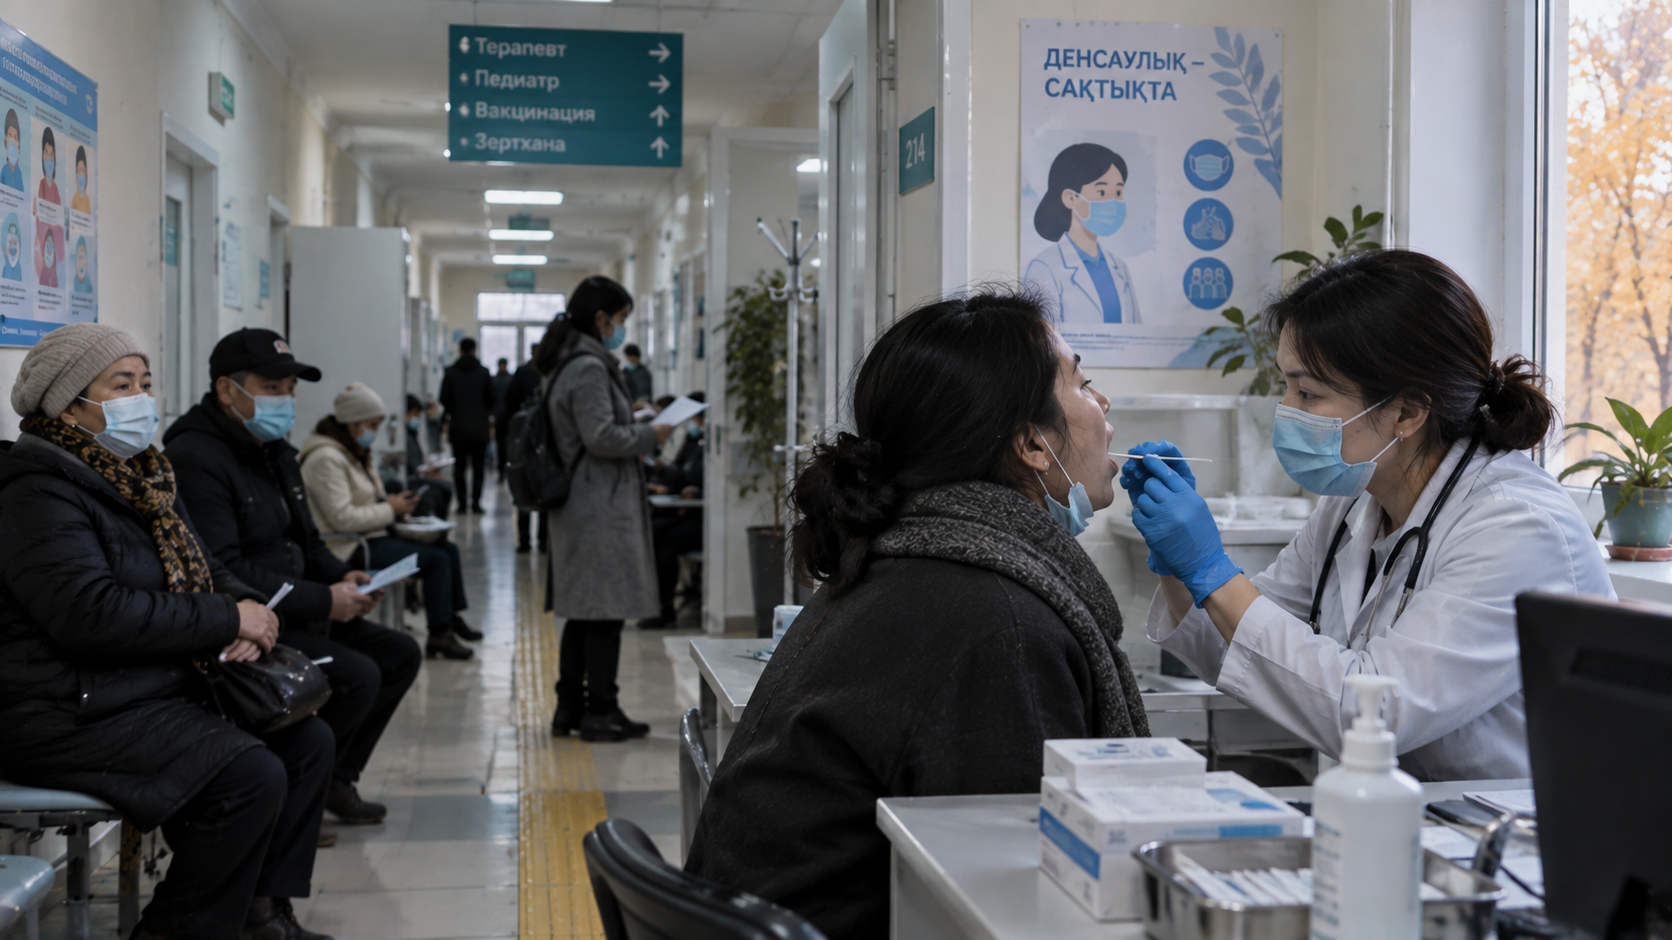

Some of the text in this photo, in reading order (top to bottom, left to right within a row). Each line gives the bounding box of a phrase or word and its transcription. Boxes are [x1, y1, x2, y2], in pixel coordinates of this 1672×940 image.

[475, 37, 567, 59] Терапевт
[1044, 48, 1187, 74] ДЕНСАУЛЫҚ
[475, 69, 559, 92] Педиатр
[1044, 78, 1177, 103] САҚТЫҚТА
[475, 102, 596, 123] Вакцинация
[475, 132, 566, 154] Зертхана
[905, 133, 925, 169] 214
